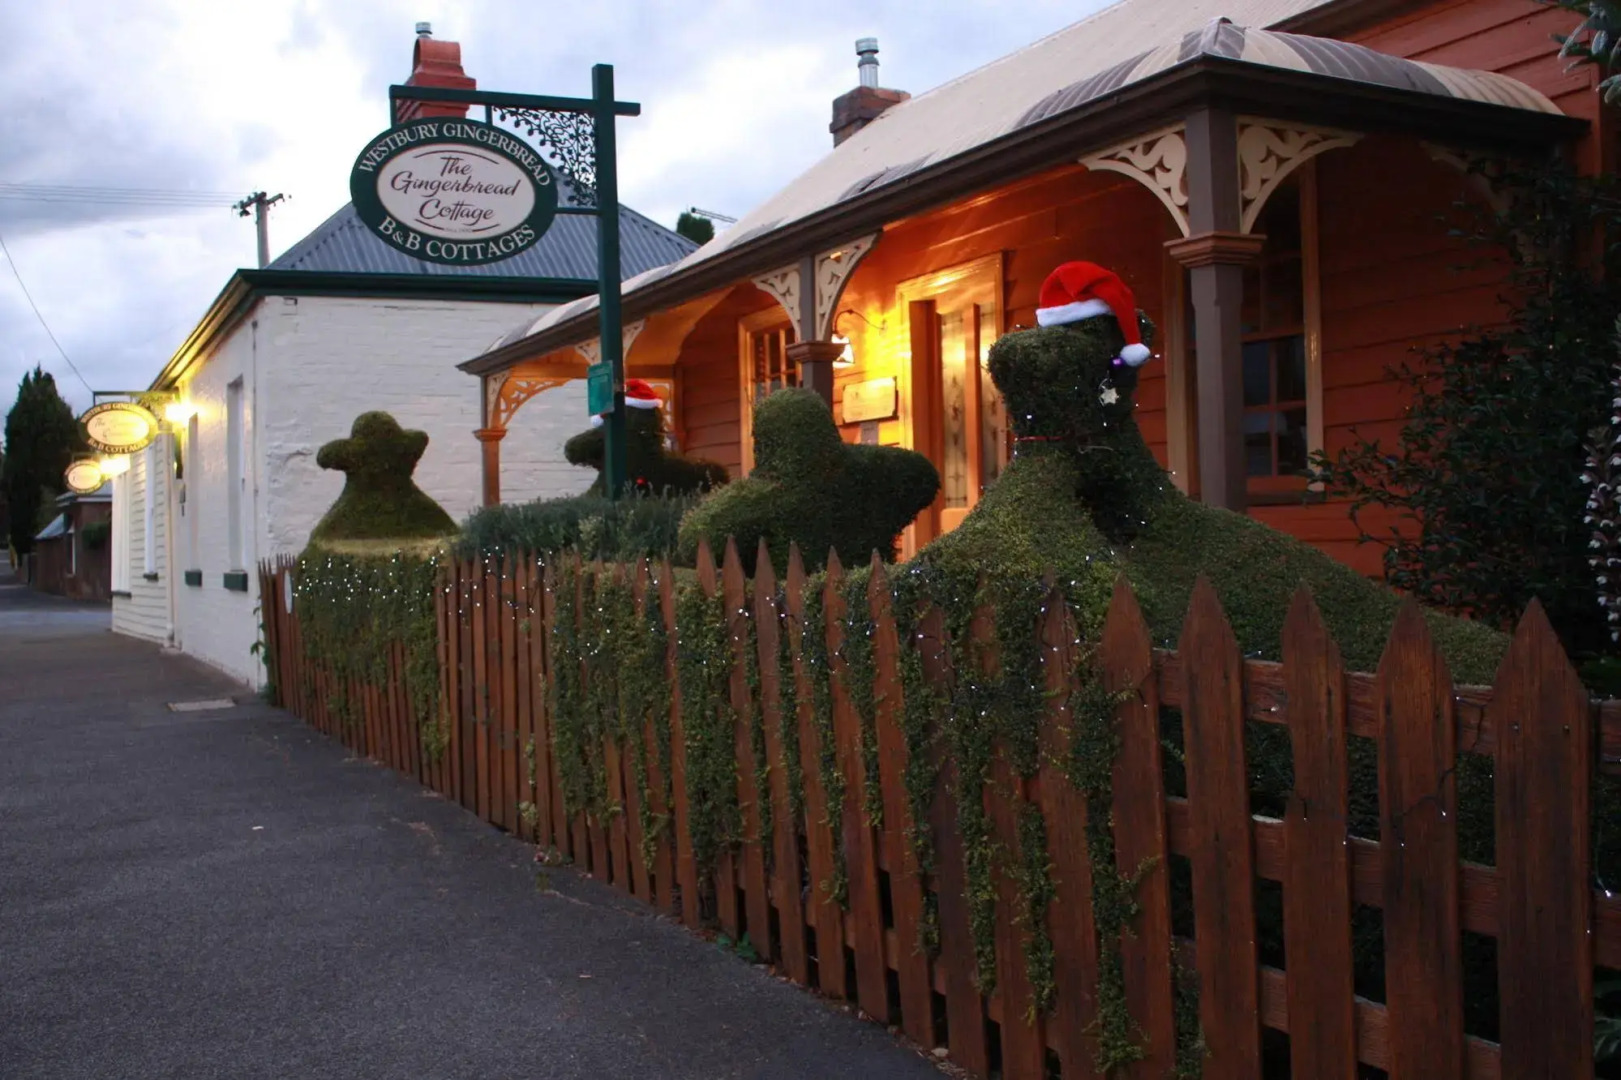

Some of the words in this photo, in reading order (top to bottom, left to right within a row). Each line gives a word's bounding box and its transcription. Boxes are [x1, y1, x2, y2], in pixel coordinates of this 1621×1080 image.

[359, 123, 439, 173] WESTBURY
[443, 123, 550, 186] GINGERBREAD
[440, 156, 473, 177] The
[391, 171, 522, 198] Gingerbread
[419, 199, 495, 226] Cottage
[378, 216, 421, 250] B&B
[426, 224, 536, 261] COTTAGES
